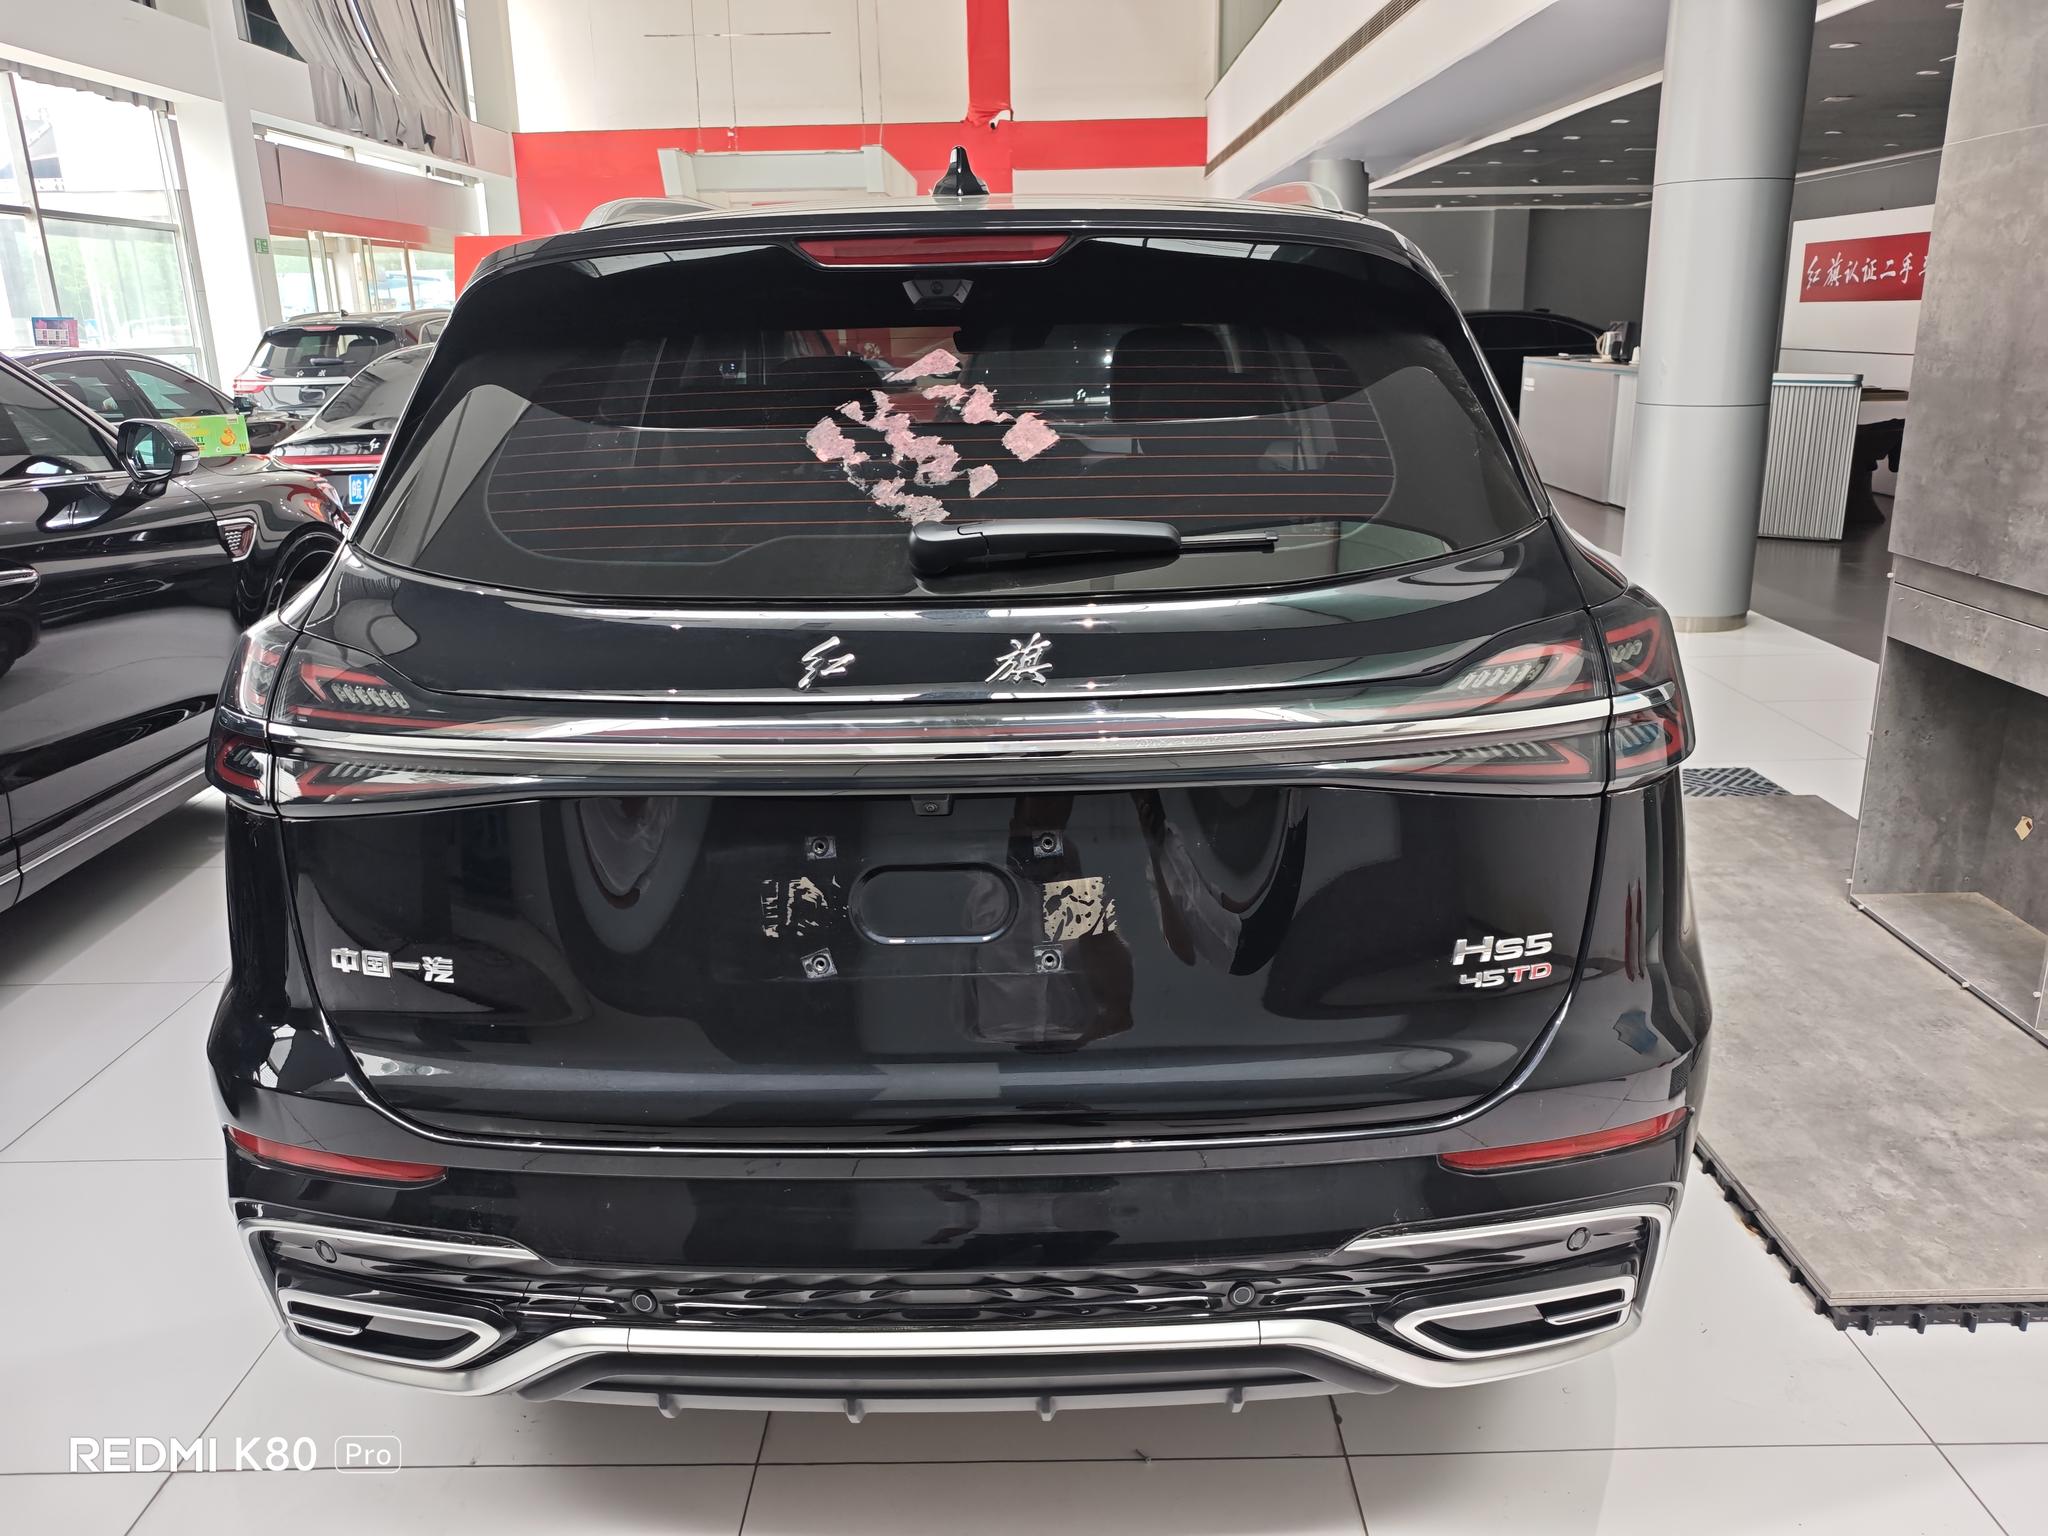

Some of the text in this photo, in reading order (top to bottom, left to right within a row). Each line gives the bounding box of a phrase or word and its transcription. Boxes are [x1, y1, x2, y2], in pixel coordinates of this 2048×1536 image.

[331, 947, 455, 983] 中国一汽
[1452, 932, 1553, 965] HS5
[1459, 963, 1552, 988] 45TD
